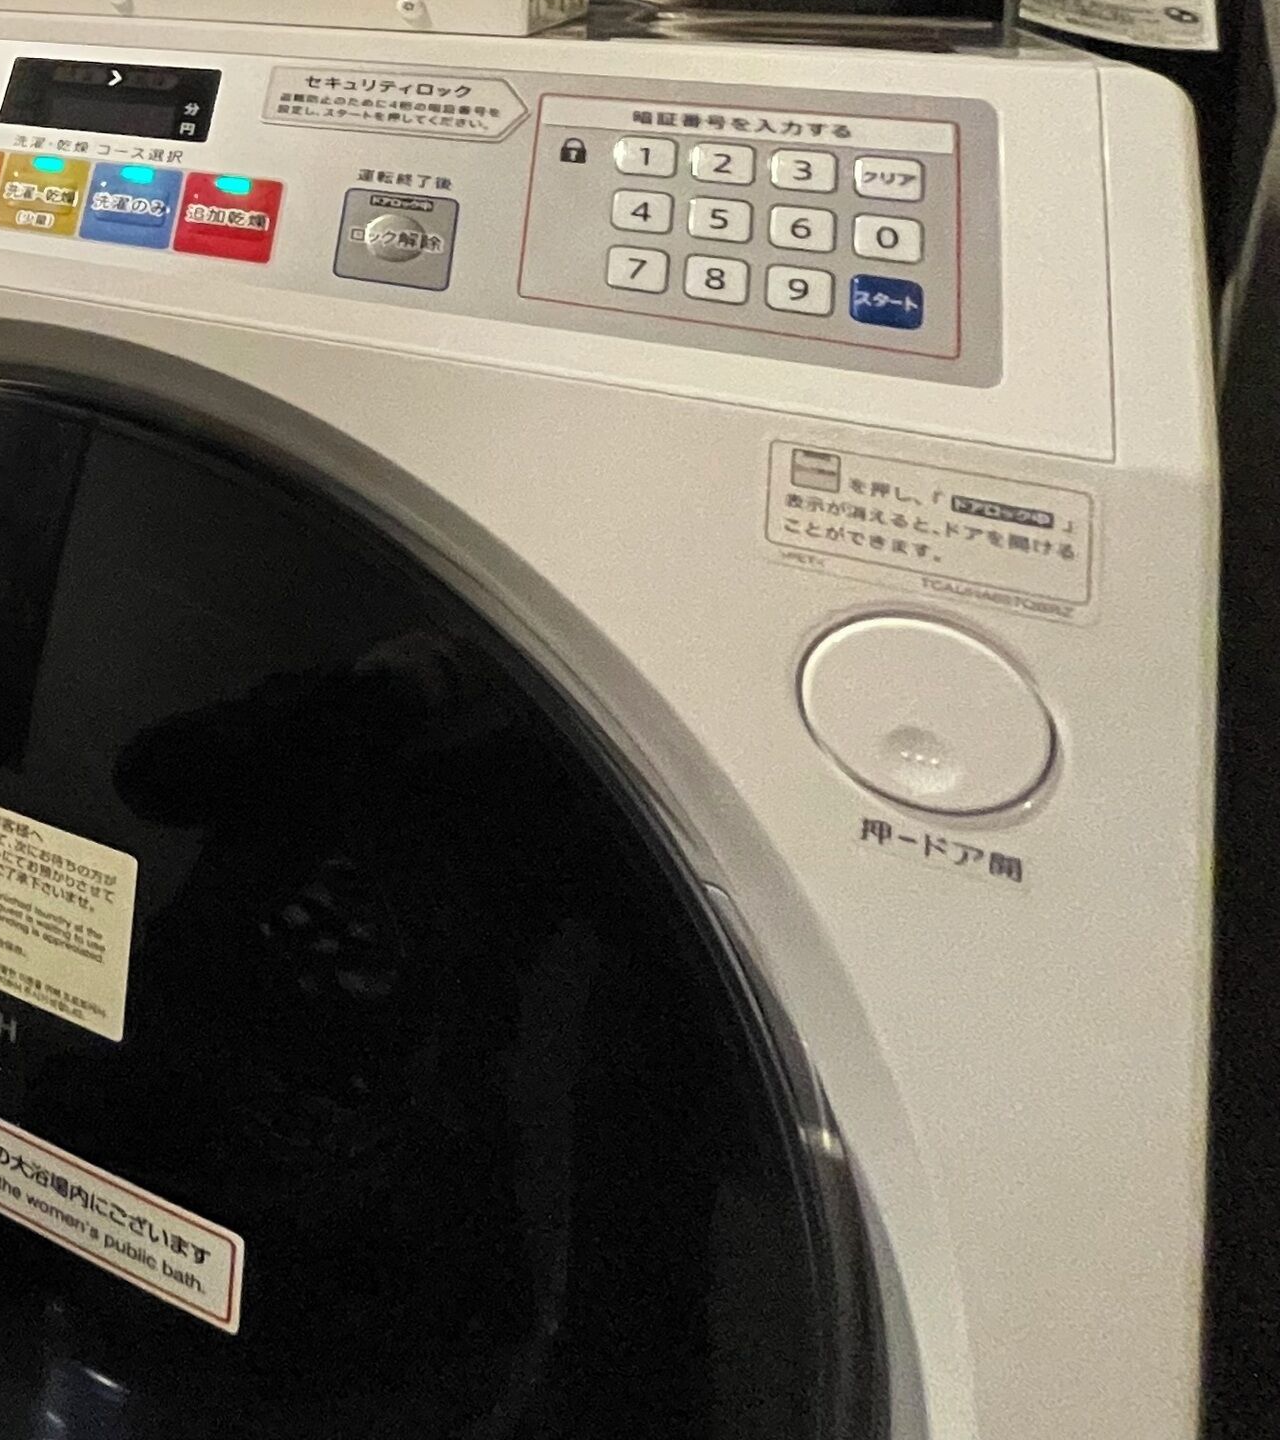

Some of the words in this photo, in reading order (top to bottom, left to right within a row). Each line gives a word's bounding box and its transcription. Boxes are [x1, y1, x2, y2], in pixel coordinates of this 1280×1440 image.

[305, 75, 472, 98] セキュリティロック
[184, 101, 200, 117] 分
[179, 122, 196, 136] 円
[632, 110, 852, 140] 暗証番号を入力する
[641, 146, 650, 166] 1
[714, 153, 732, 174] 2
[793, 160, 812, 181] 3
[357, 169, 452, 190] 運転終了後
[863, 171, 917, 187] クリア
[94, 192, 171, 216] 洗濯のみ
[187, 206, 270, 230] 追加乾燥
[631, 202, 651, 222] 4
[710, 209, 728, 229] 5
[791, 218, 811, 238] 6
[877, 227, 898, 248] 0
[351, 229, 442, 252] ロック解除
[629, 259, 647, 279] 7
[705, 268, 724, 290] 8
[789, 279, 808, 300] 9
[855, 291, 918, 311] スタート
[784, 518, 942, 563] ことができます。
[25, 1188, 100, 1244] women's
[103, 1229, 157, 1275] public
[160, 1257, 206, 1299] bath.
